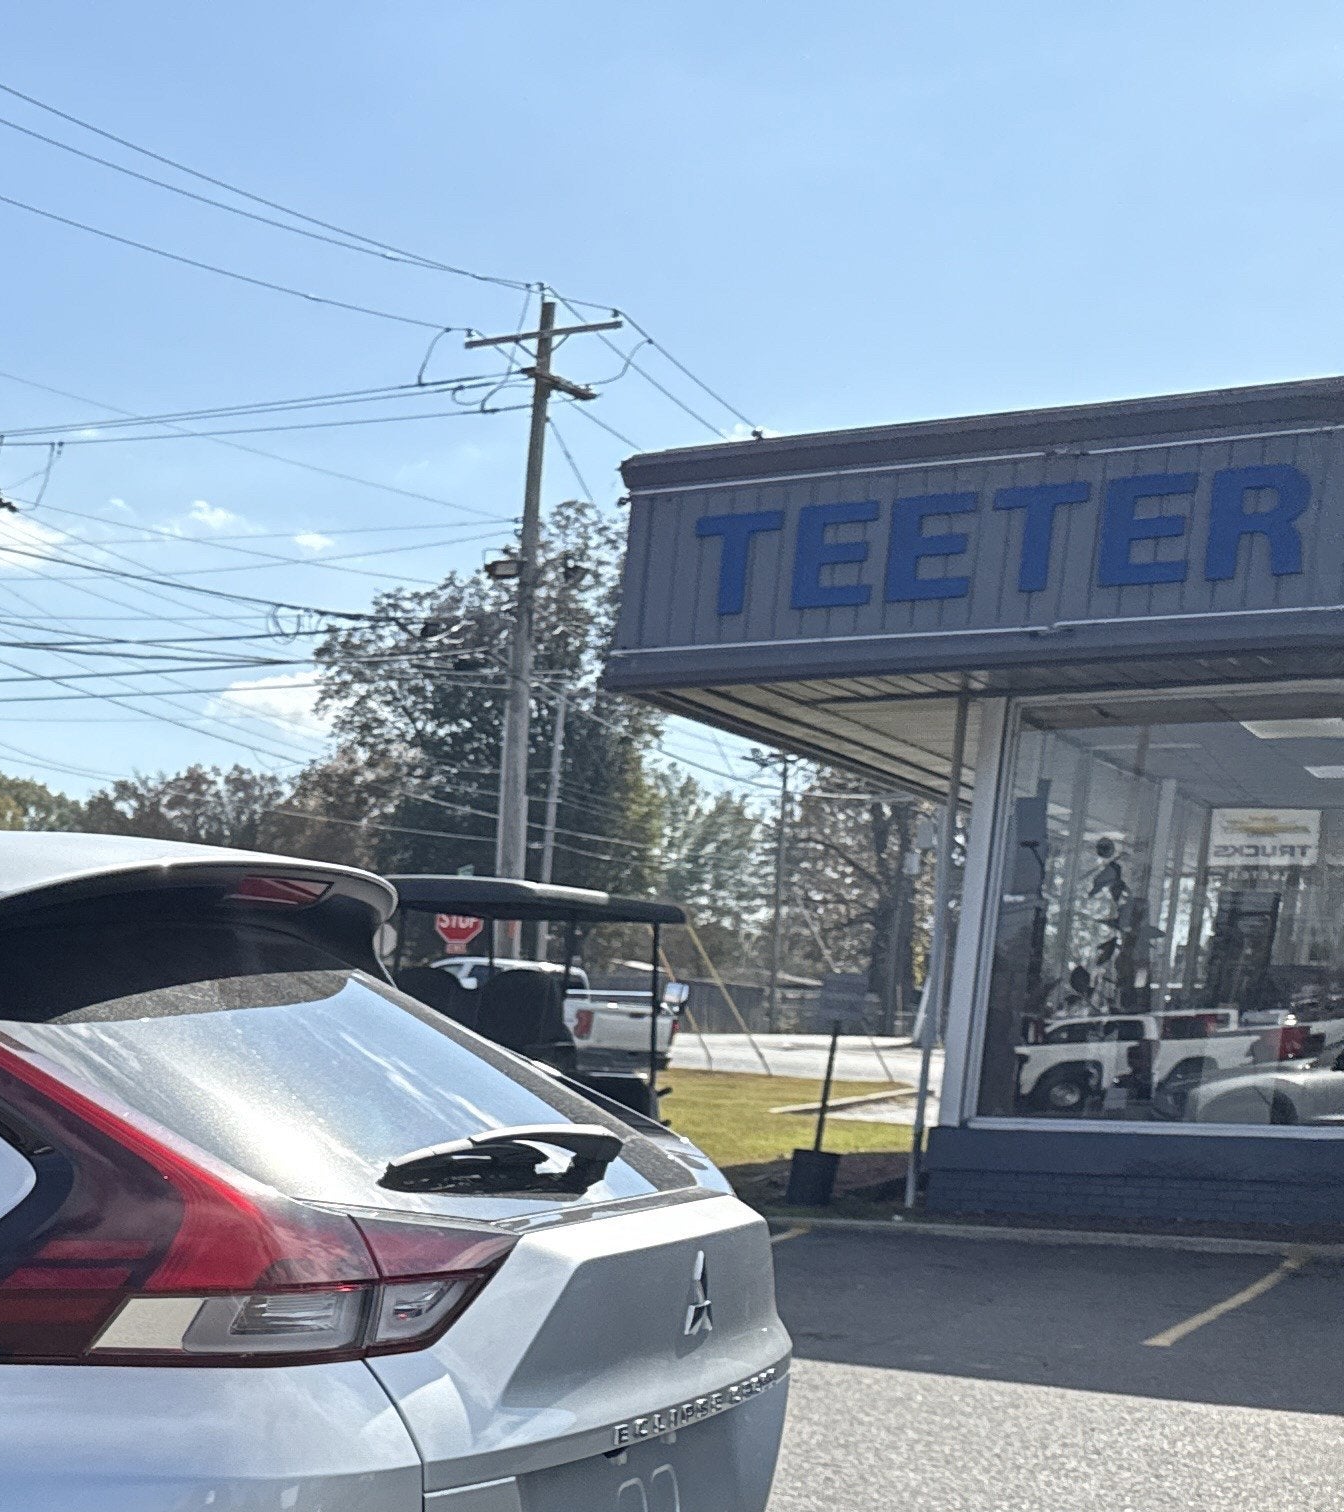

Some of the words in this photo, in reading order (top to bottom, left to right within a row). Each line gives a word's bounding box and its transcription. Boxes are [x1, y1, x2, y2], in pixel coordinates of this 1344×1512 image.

[696, 464, 1311, 616] TEETER
[438, 914, 478, 928] STOP
[614, 1393, 722, 1445] ECLIPSE
